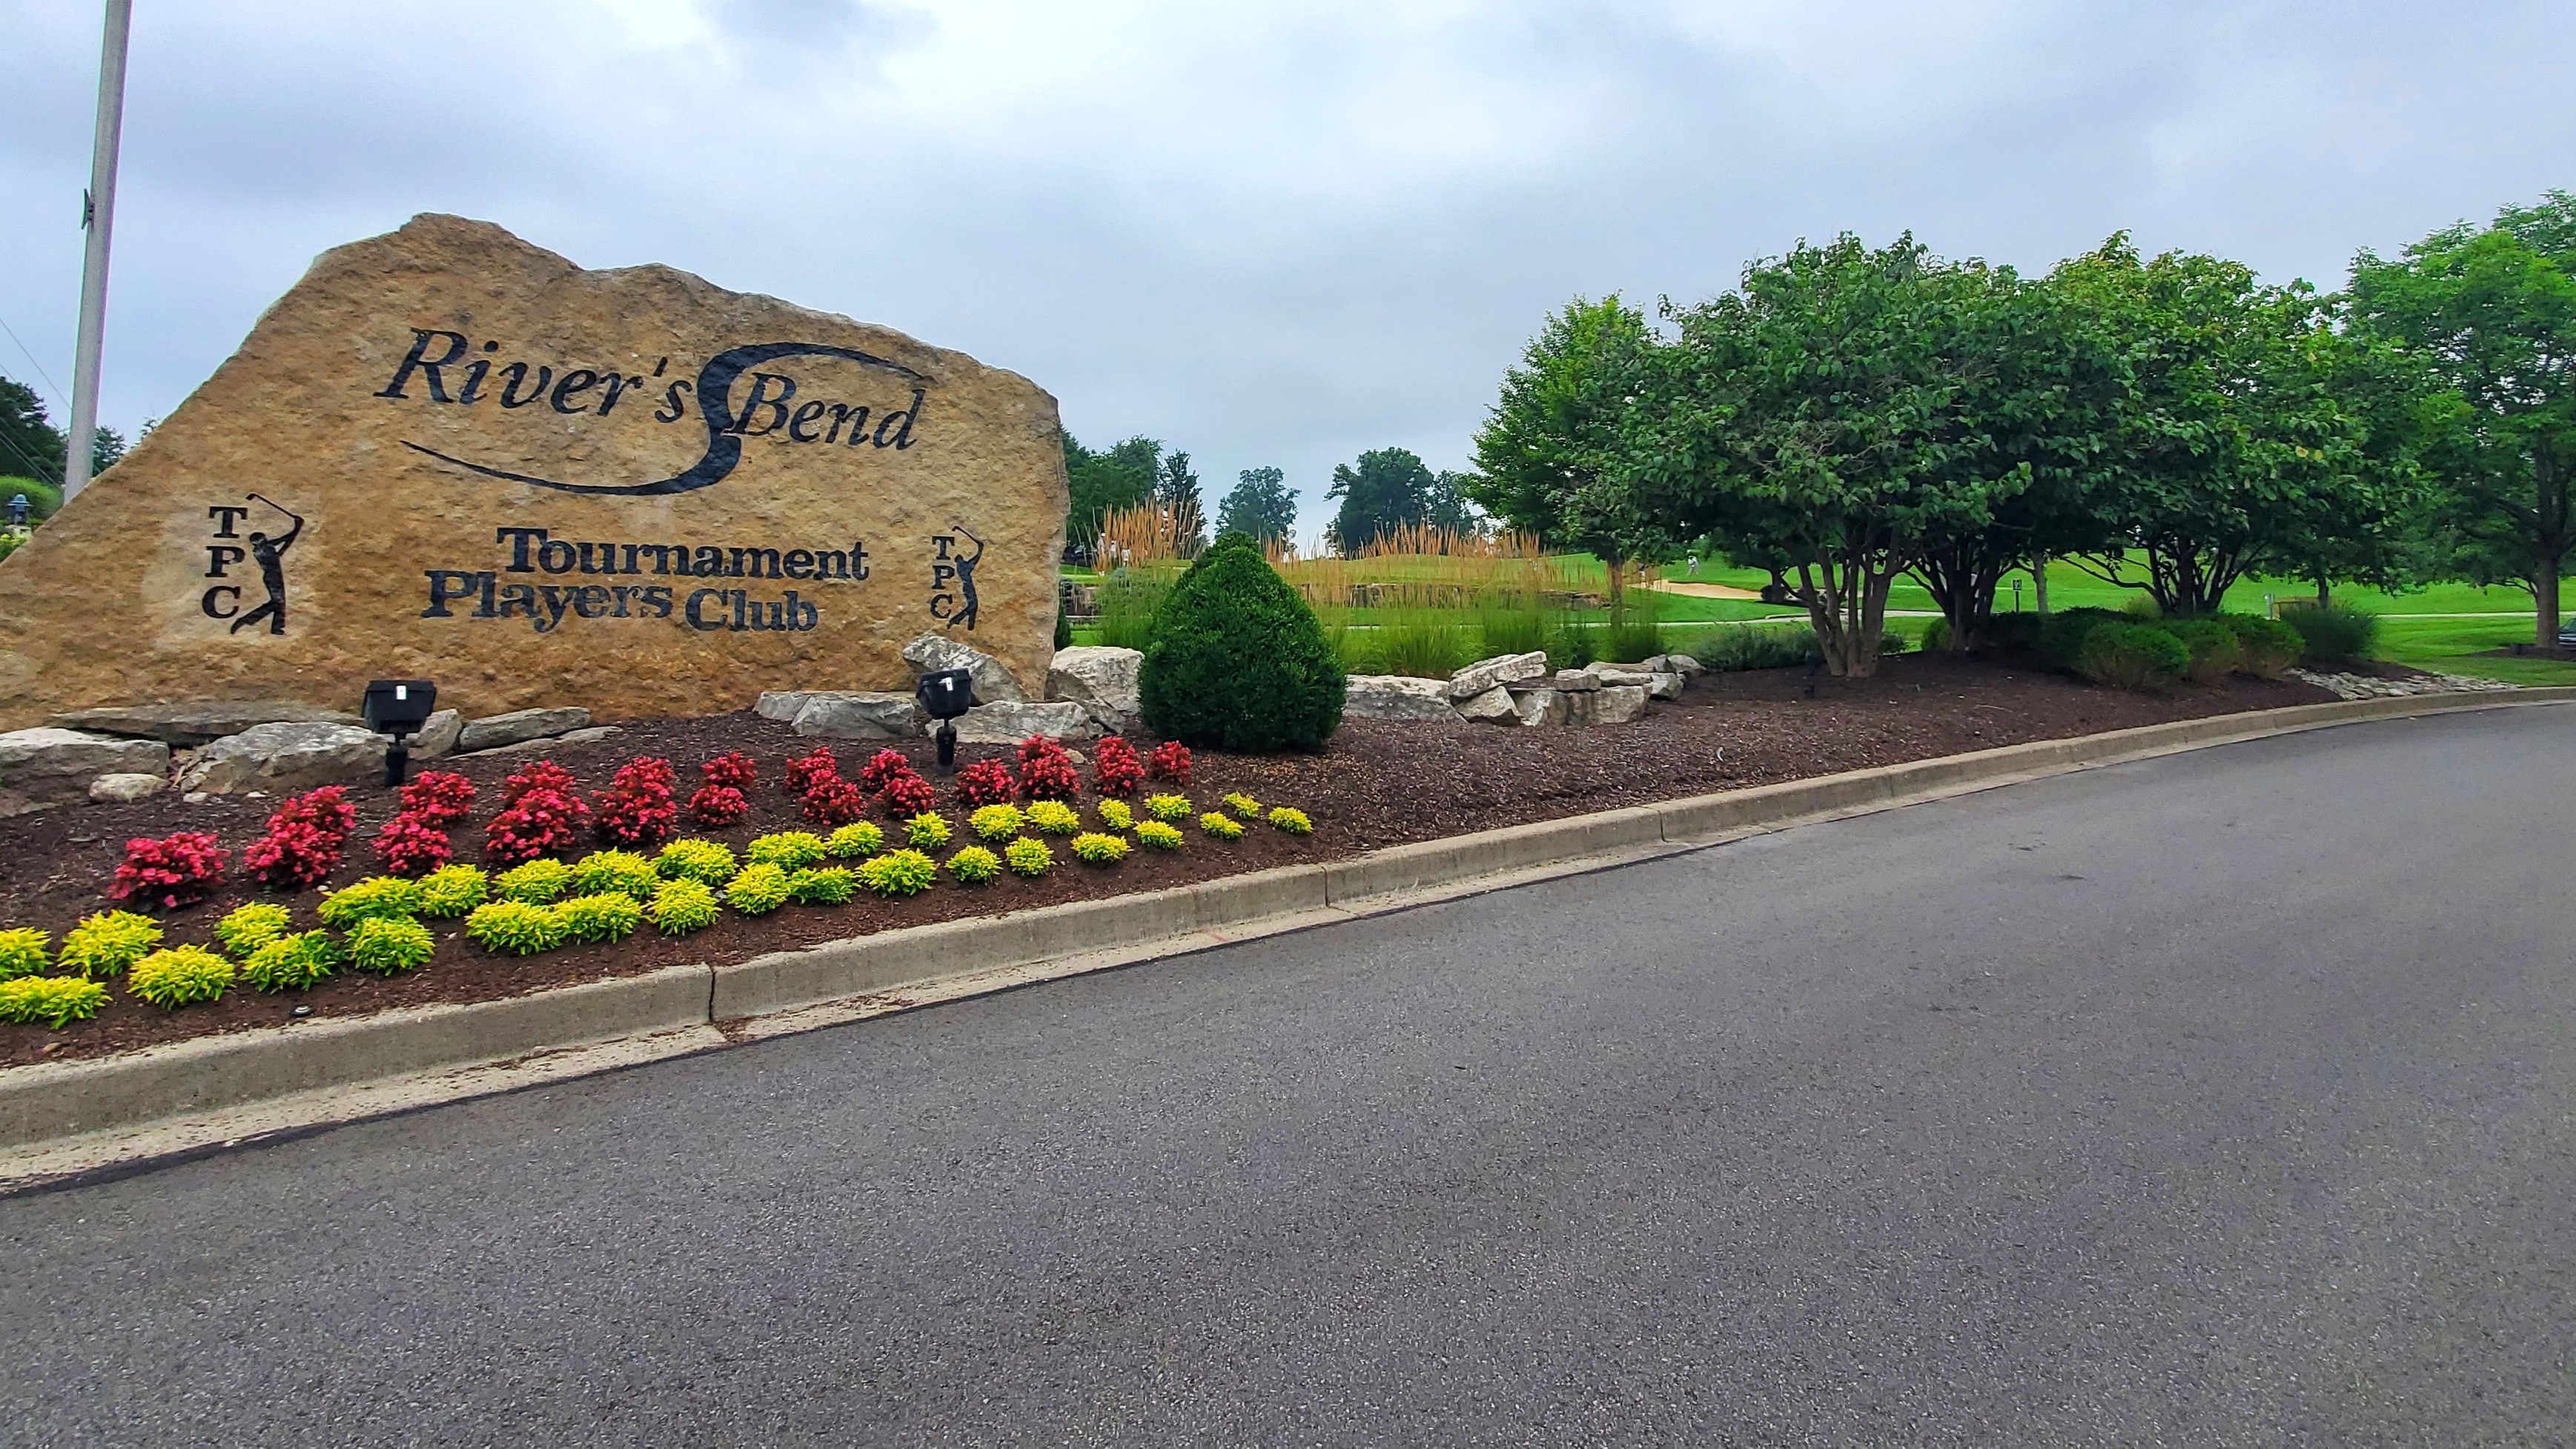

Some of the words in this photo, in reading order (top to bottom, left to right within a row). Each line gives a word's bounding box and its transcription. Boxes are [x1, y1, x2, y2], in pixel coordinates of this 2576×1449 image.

[373, 327, 694, 423] River's
[732, 371, 926, 451] Bend
[202, 505, 248, 619] TPC
[497, 526, 870, 581] Tournament
[930, 535, 955, 619] TPC
[420, 569, 672, 633] Players
[685, 586, 818, 632] Club
